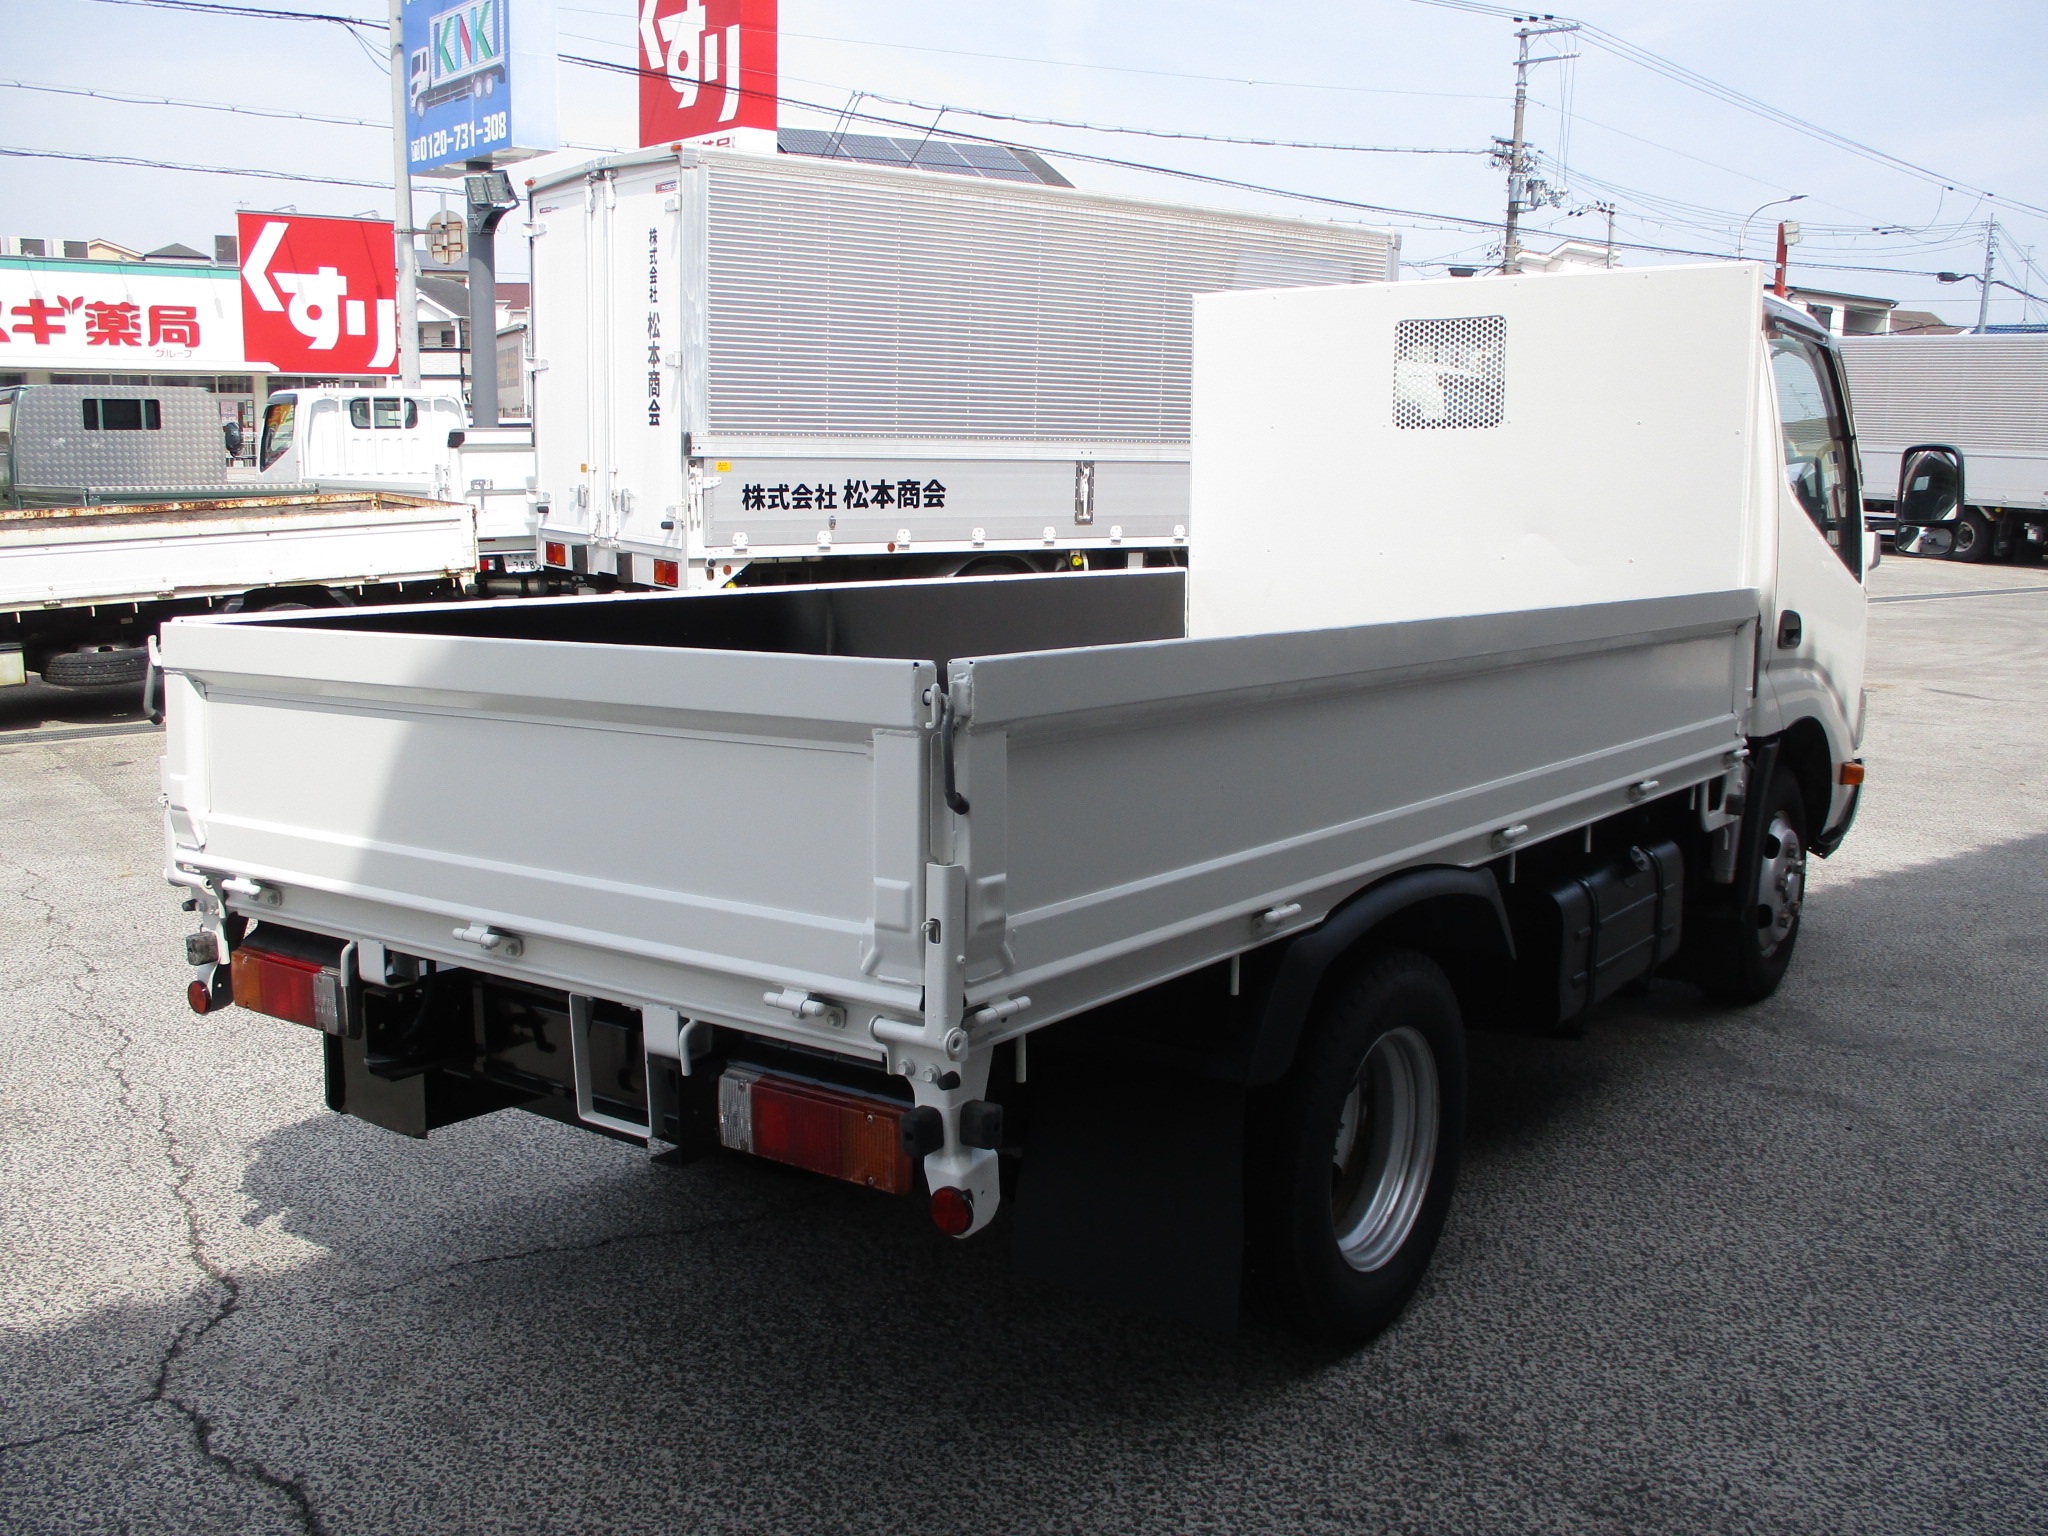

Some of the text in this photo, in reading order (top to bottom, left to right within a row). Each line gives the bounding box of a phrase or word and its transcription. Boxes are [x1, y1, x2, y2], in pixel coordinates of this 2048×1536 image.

[420, 111, 507, 161] 0120-731-308
[241, 221, 395, 369] くすり
[647, 227, 661, 427] 株式会社 松本商会
[741, 478, 947, 511] 株式会社 松本商会
